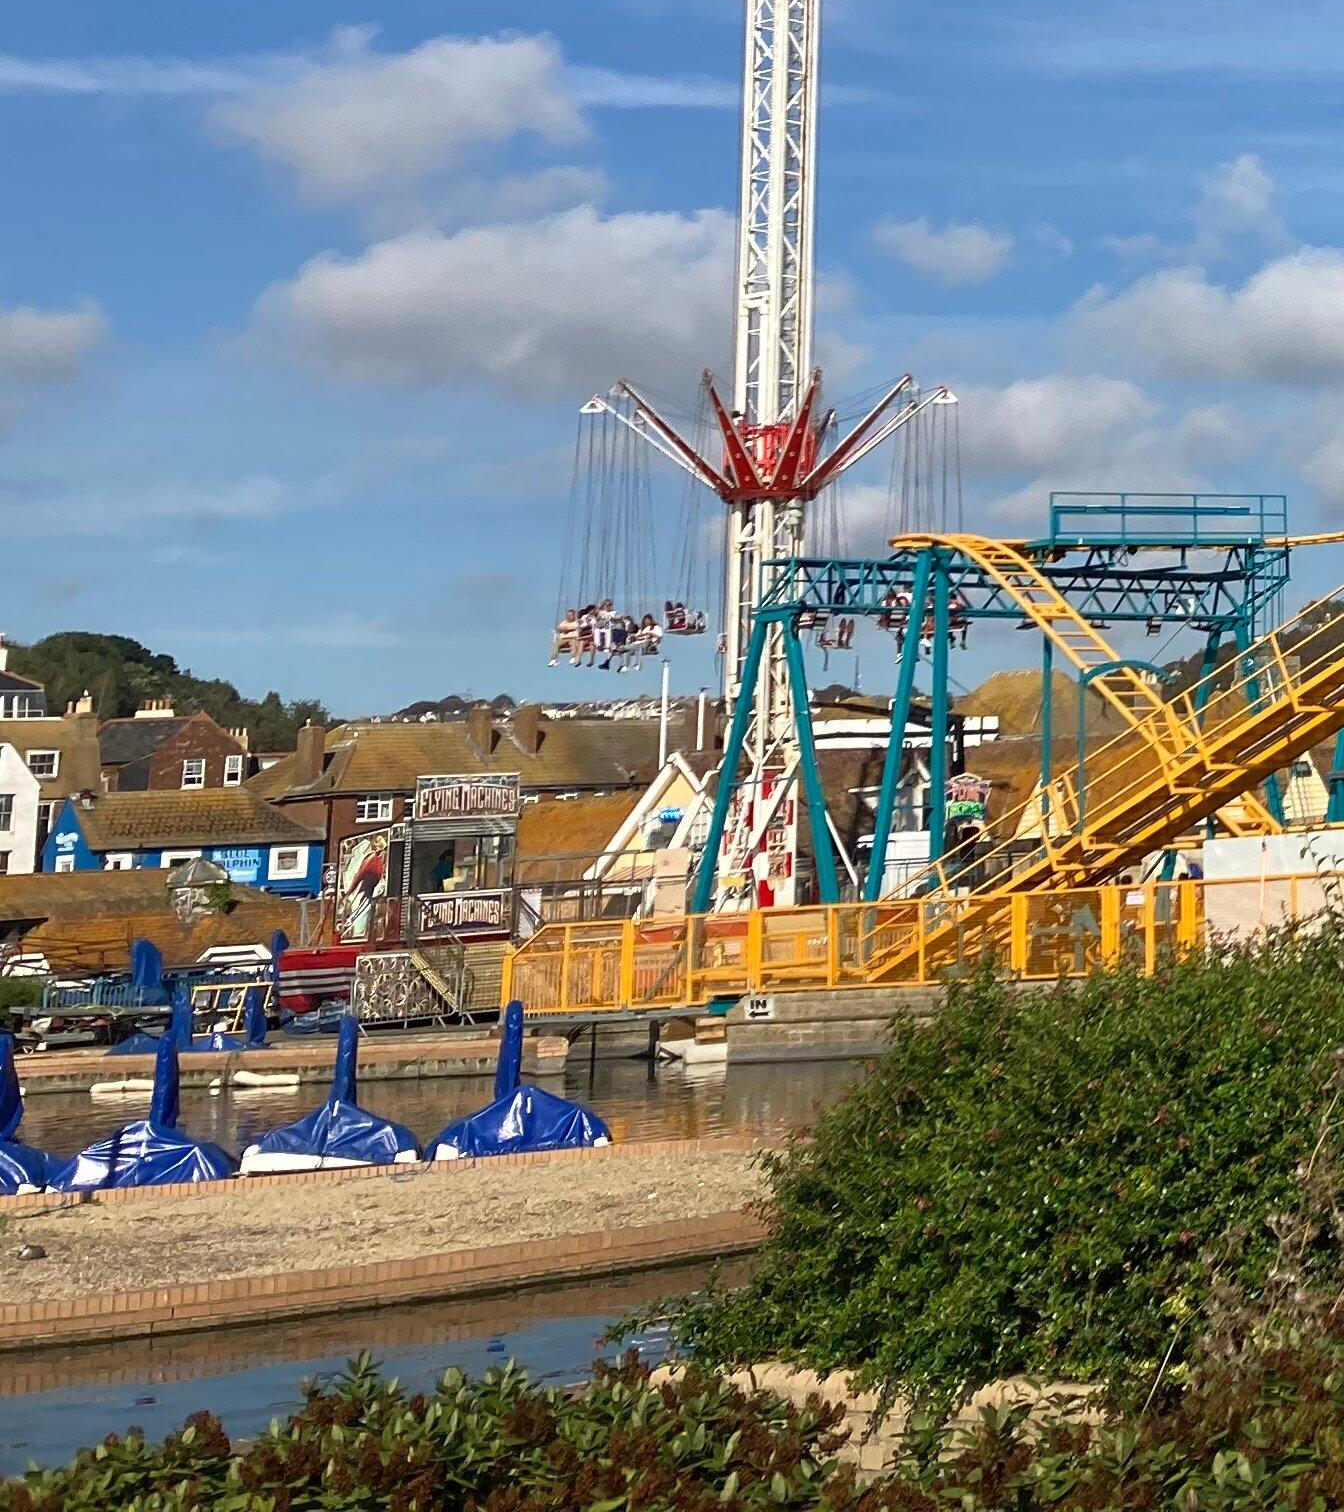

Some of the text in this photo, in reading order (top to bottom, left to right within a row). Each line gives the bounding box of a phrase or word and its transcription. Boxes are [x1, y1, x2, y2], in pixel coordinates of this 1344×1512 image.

[420, 785, 516, 818] FLYING MACHINES
[221, 858, 260, 869] LPHIN
[453, 898, 500, 926] MACHINES
[750, 999, 767, 1009] IN
